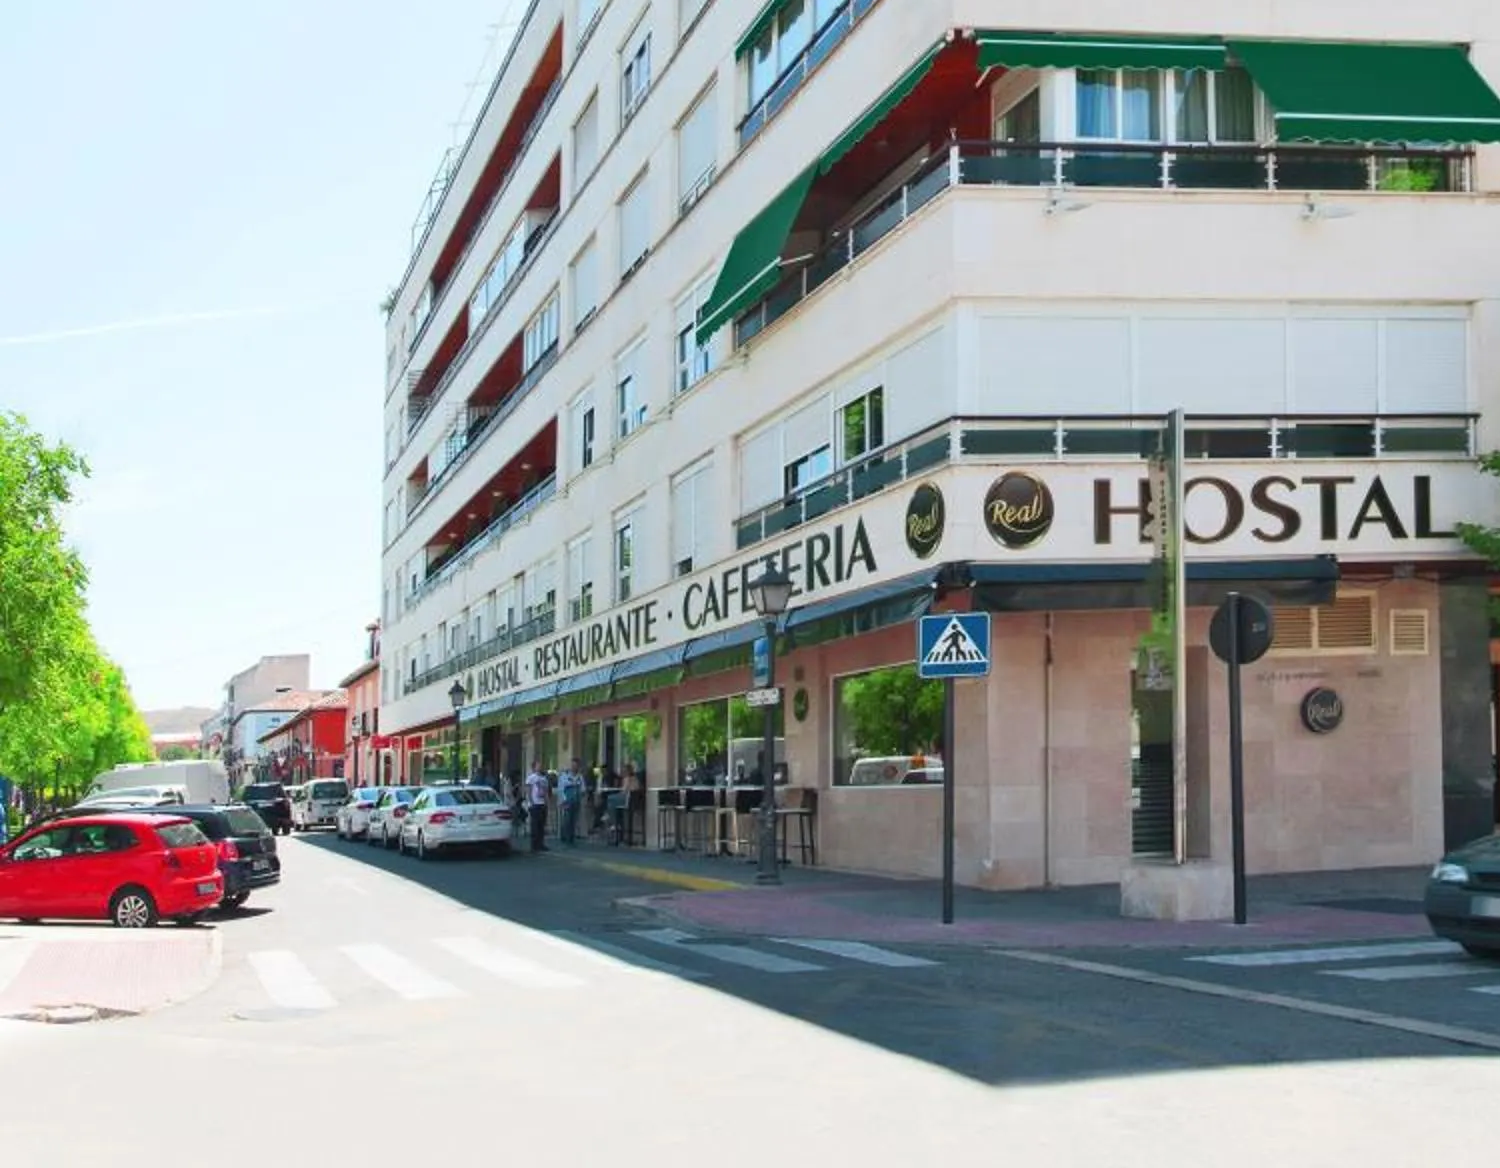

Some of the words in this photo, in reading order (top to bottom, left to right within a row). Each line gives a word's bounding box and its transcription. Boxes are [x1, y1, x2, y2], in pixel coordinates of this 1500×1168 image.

[908, 499, 938, 540] Real
[987, 490, 1042, 526] Real
[1093, 475, 1459, 545] HOSTAL
[477, 655, 521, 698] HOSTAL
[535, 600, 658, 680] RESTAURANTE
